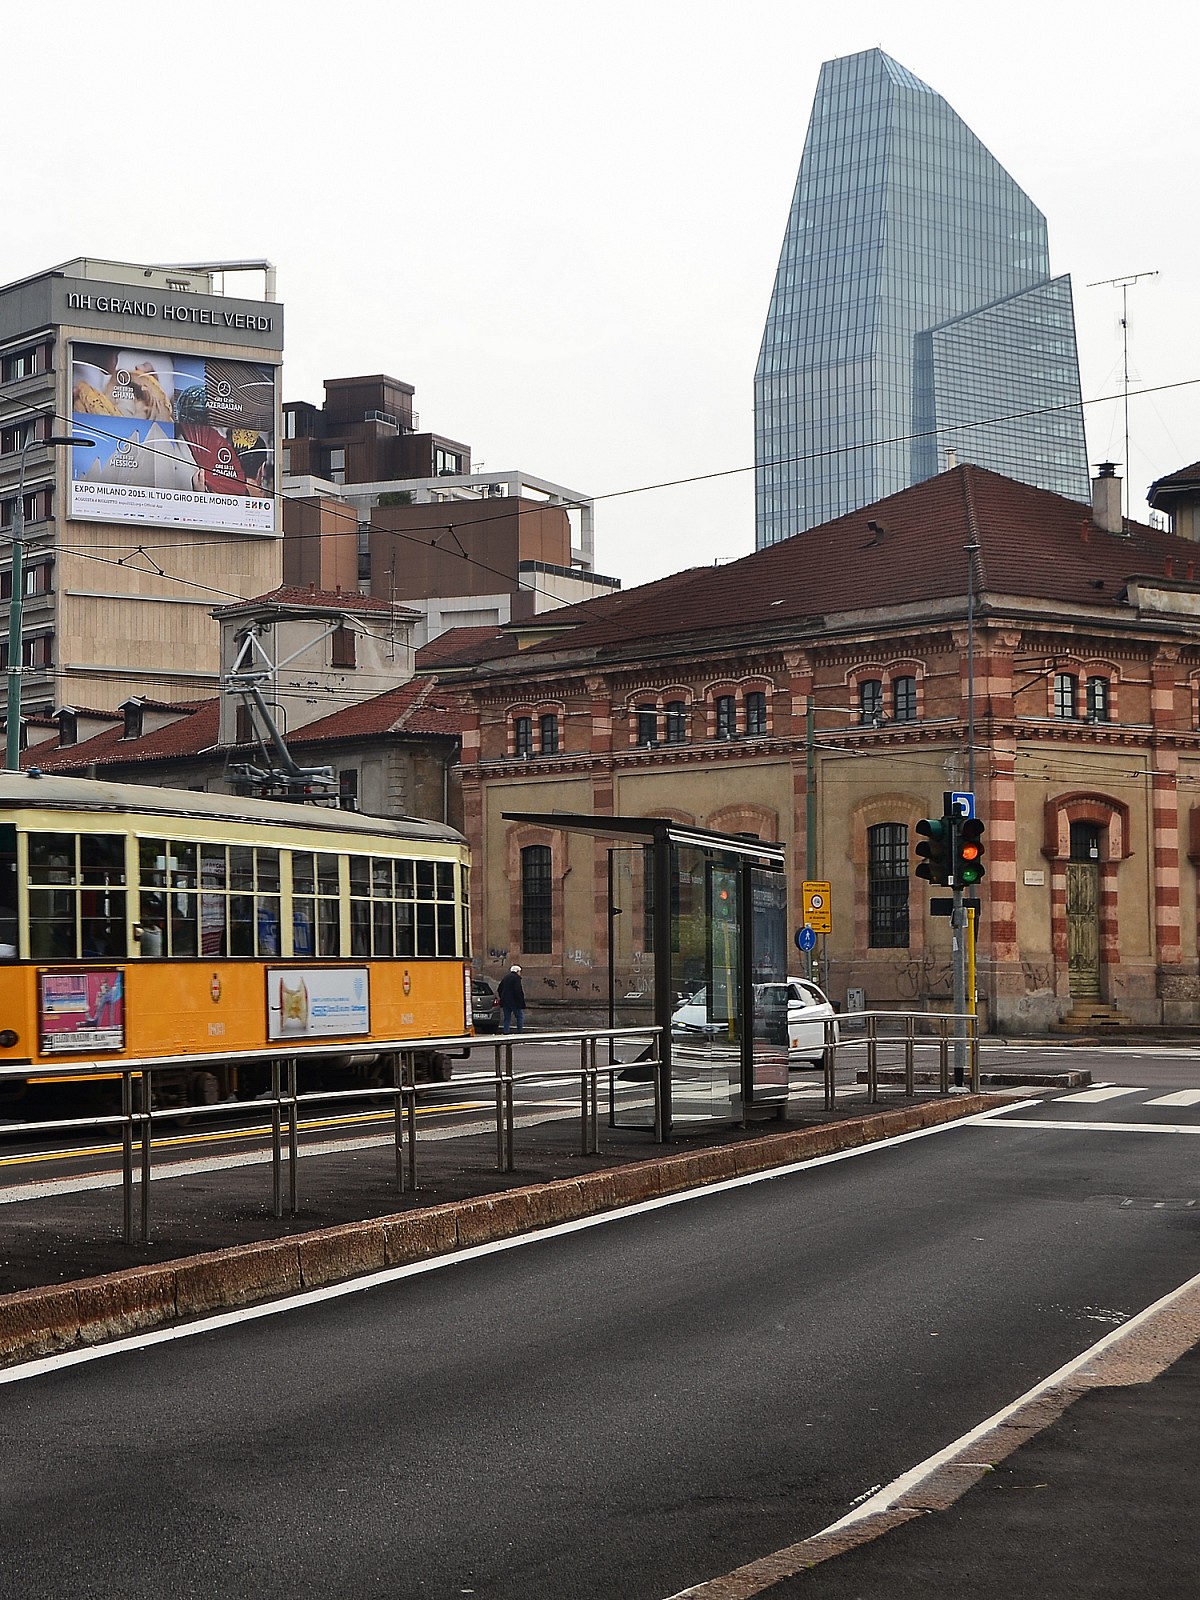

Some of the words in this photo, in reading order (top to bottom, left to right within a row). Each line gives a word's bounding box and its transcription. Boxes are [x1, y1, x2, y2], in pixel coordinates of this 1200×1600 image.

[96, 296, 158, 317] GRAND
[162, 304, 219, 325] HOTEL
[223, 312, 274, 332] VERDI
[112, 391, 134, 400] GHANA
[110, 459, 138, 468] MESSICO
[74, 485, 95, 494] EXPO
[96, 487, 126, 496] MILANO
[156, 492, 172, 500] TUO
[174, 494, 192, 502] GIRO
[194, 496, 208, 504] DEL
[245, 500, 270, 510] EXPO
